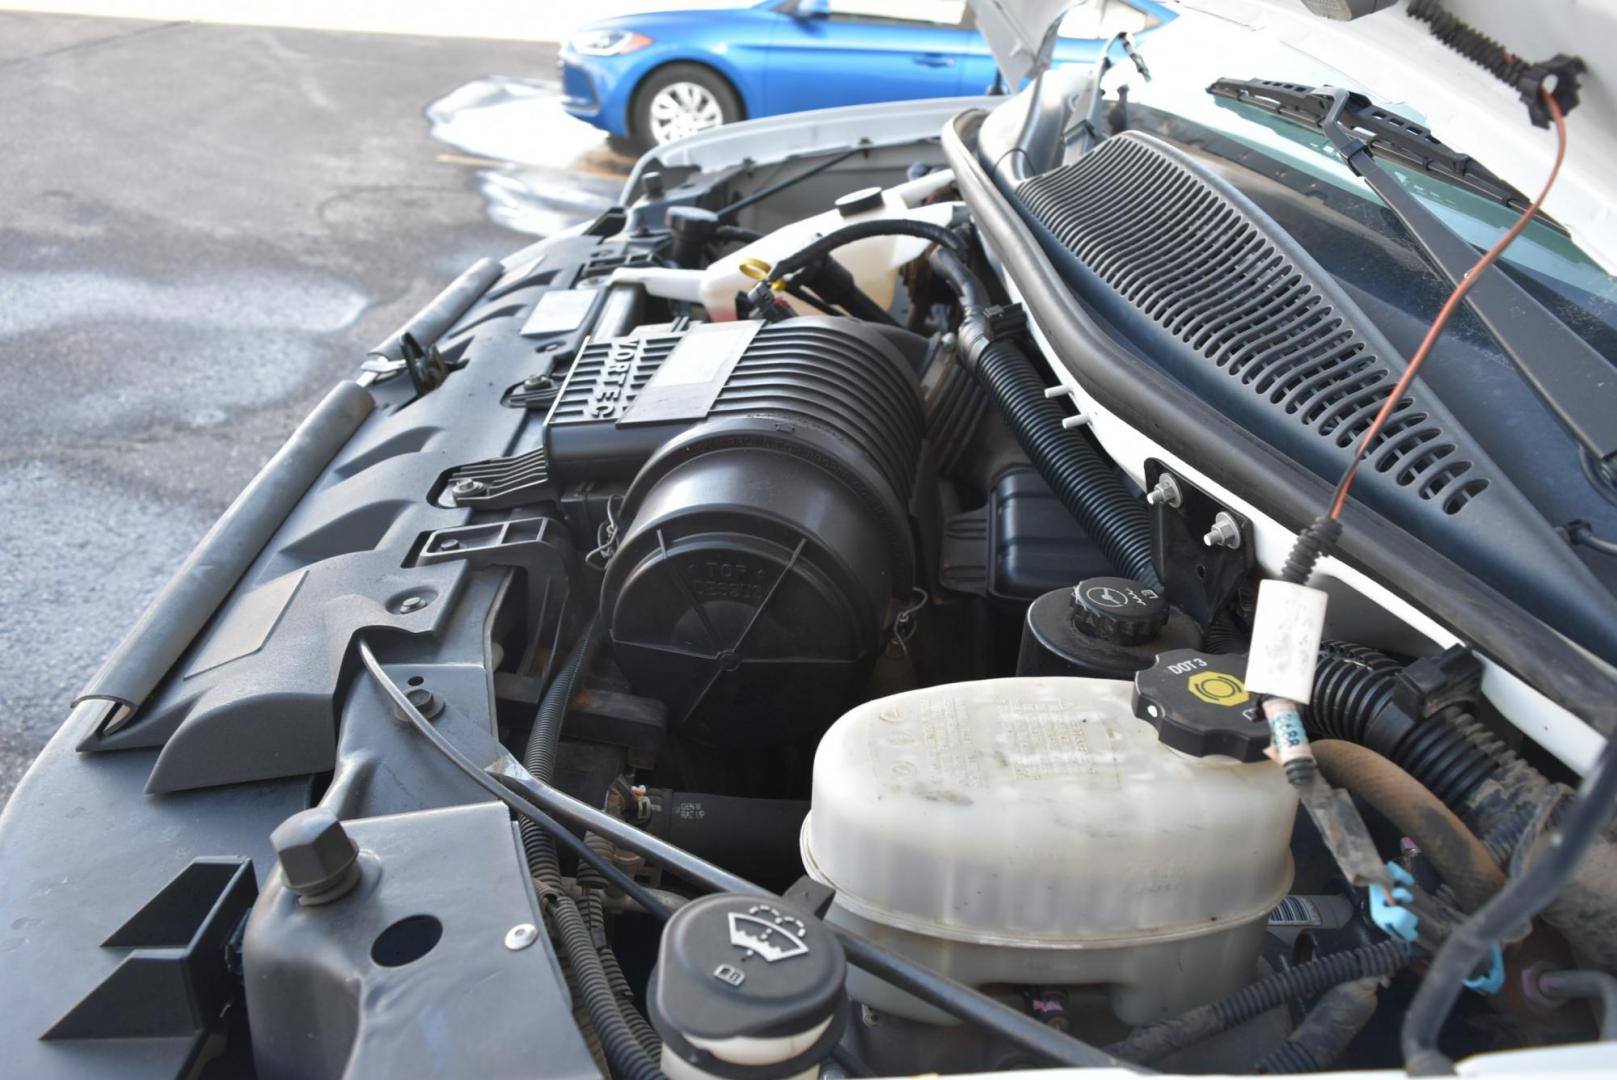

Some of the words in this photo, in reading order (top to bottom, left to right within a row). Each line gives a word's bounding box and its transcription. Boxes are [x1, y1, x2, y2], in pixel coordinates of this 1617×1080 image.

[592, 339, 640, 418] VORTEC
[1167, 660, 1198, 674] DOT
[1193, 658, 1208, 667] 3
